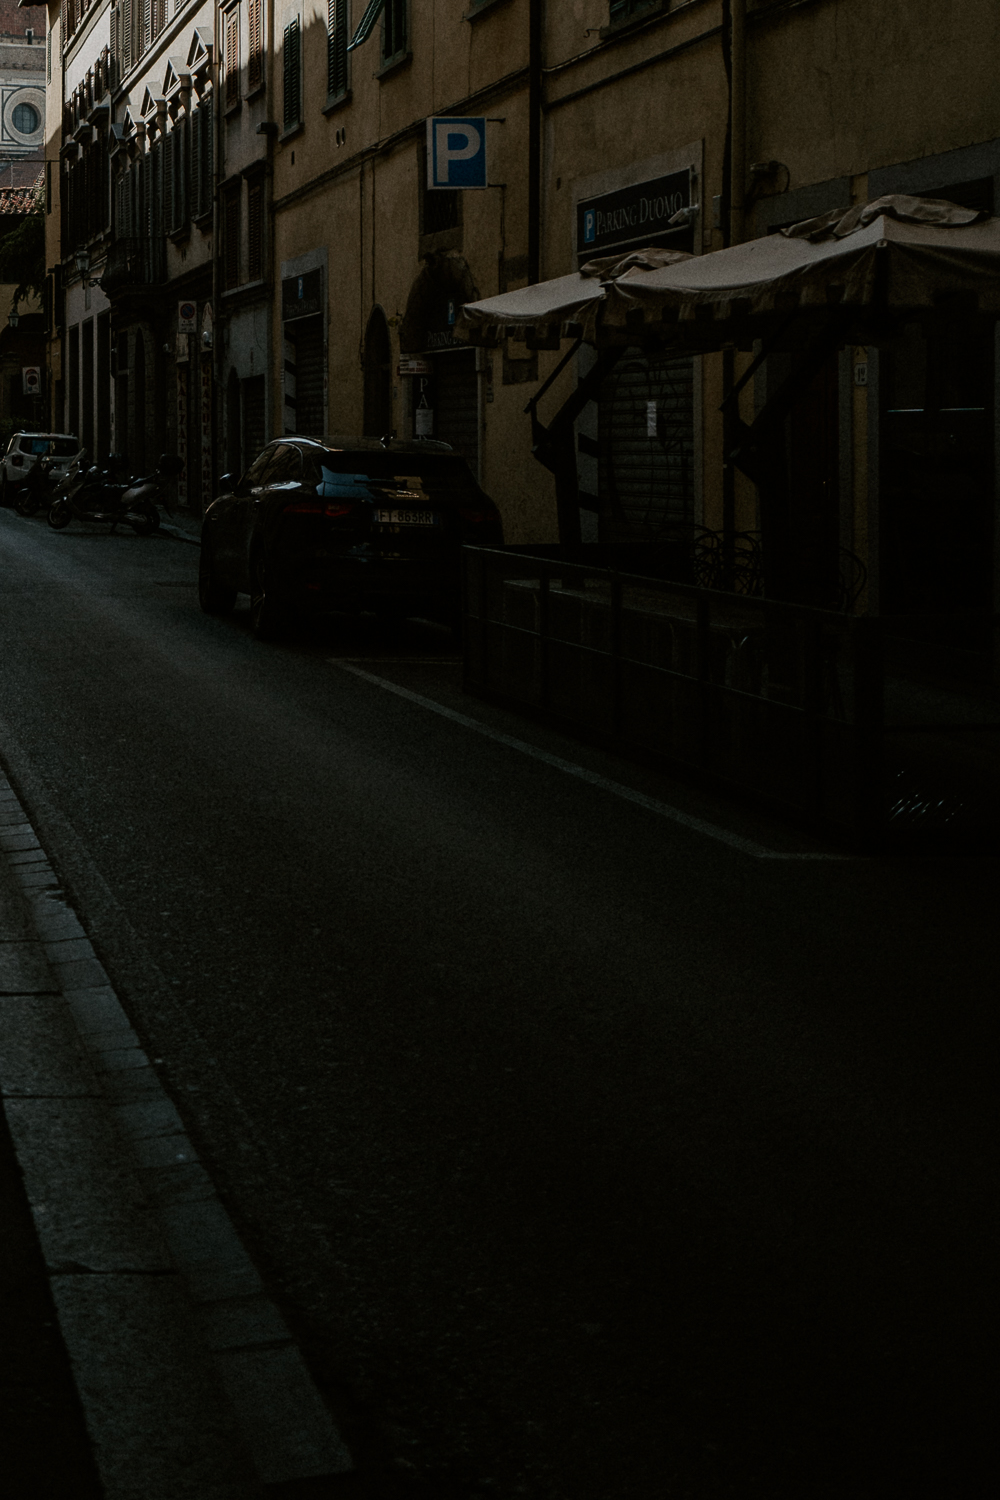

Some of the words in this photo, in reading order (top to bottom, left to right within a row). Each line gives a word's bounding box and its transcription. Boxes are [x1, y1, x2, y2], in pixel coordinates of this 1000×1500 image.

[435, 123, 480, 183] P
[586, 213, 594, 238] P
[596, 204, 637, 235] PARKING
[640, 191, 683, 223] DUOMO
